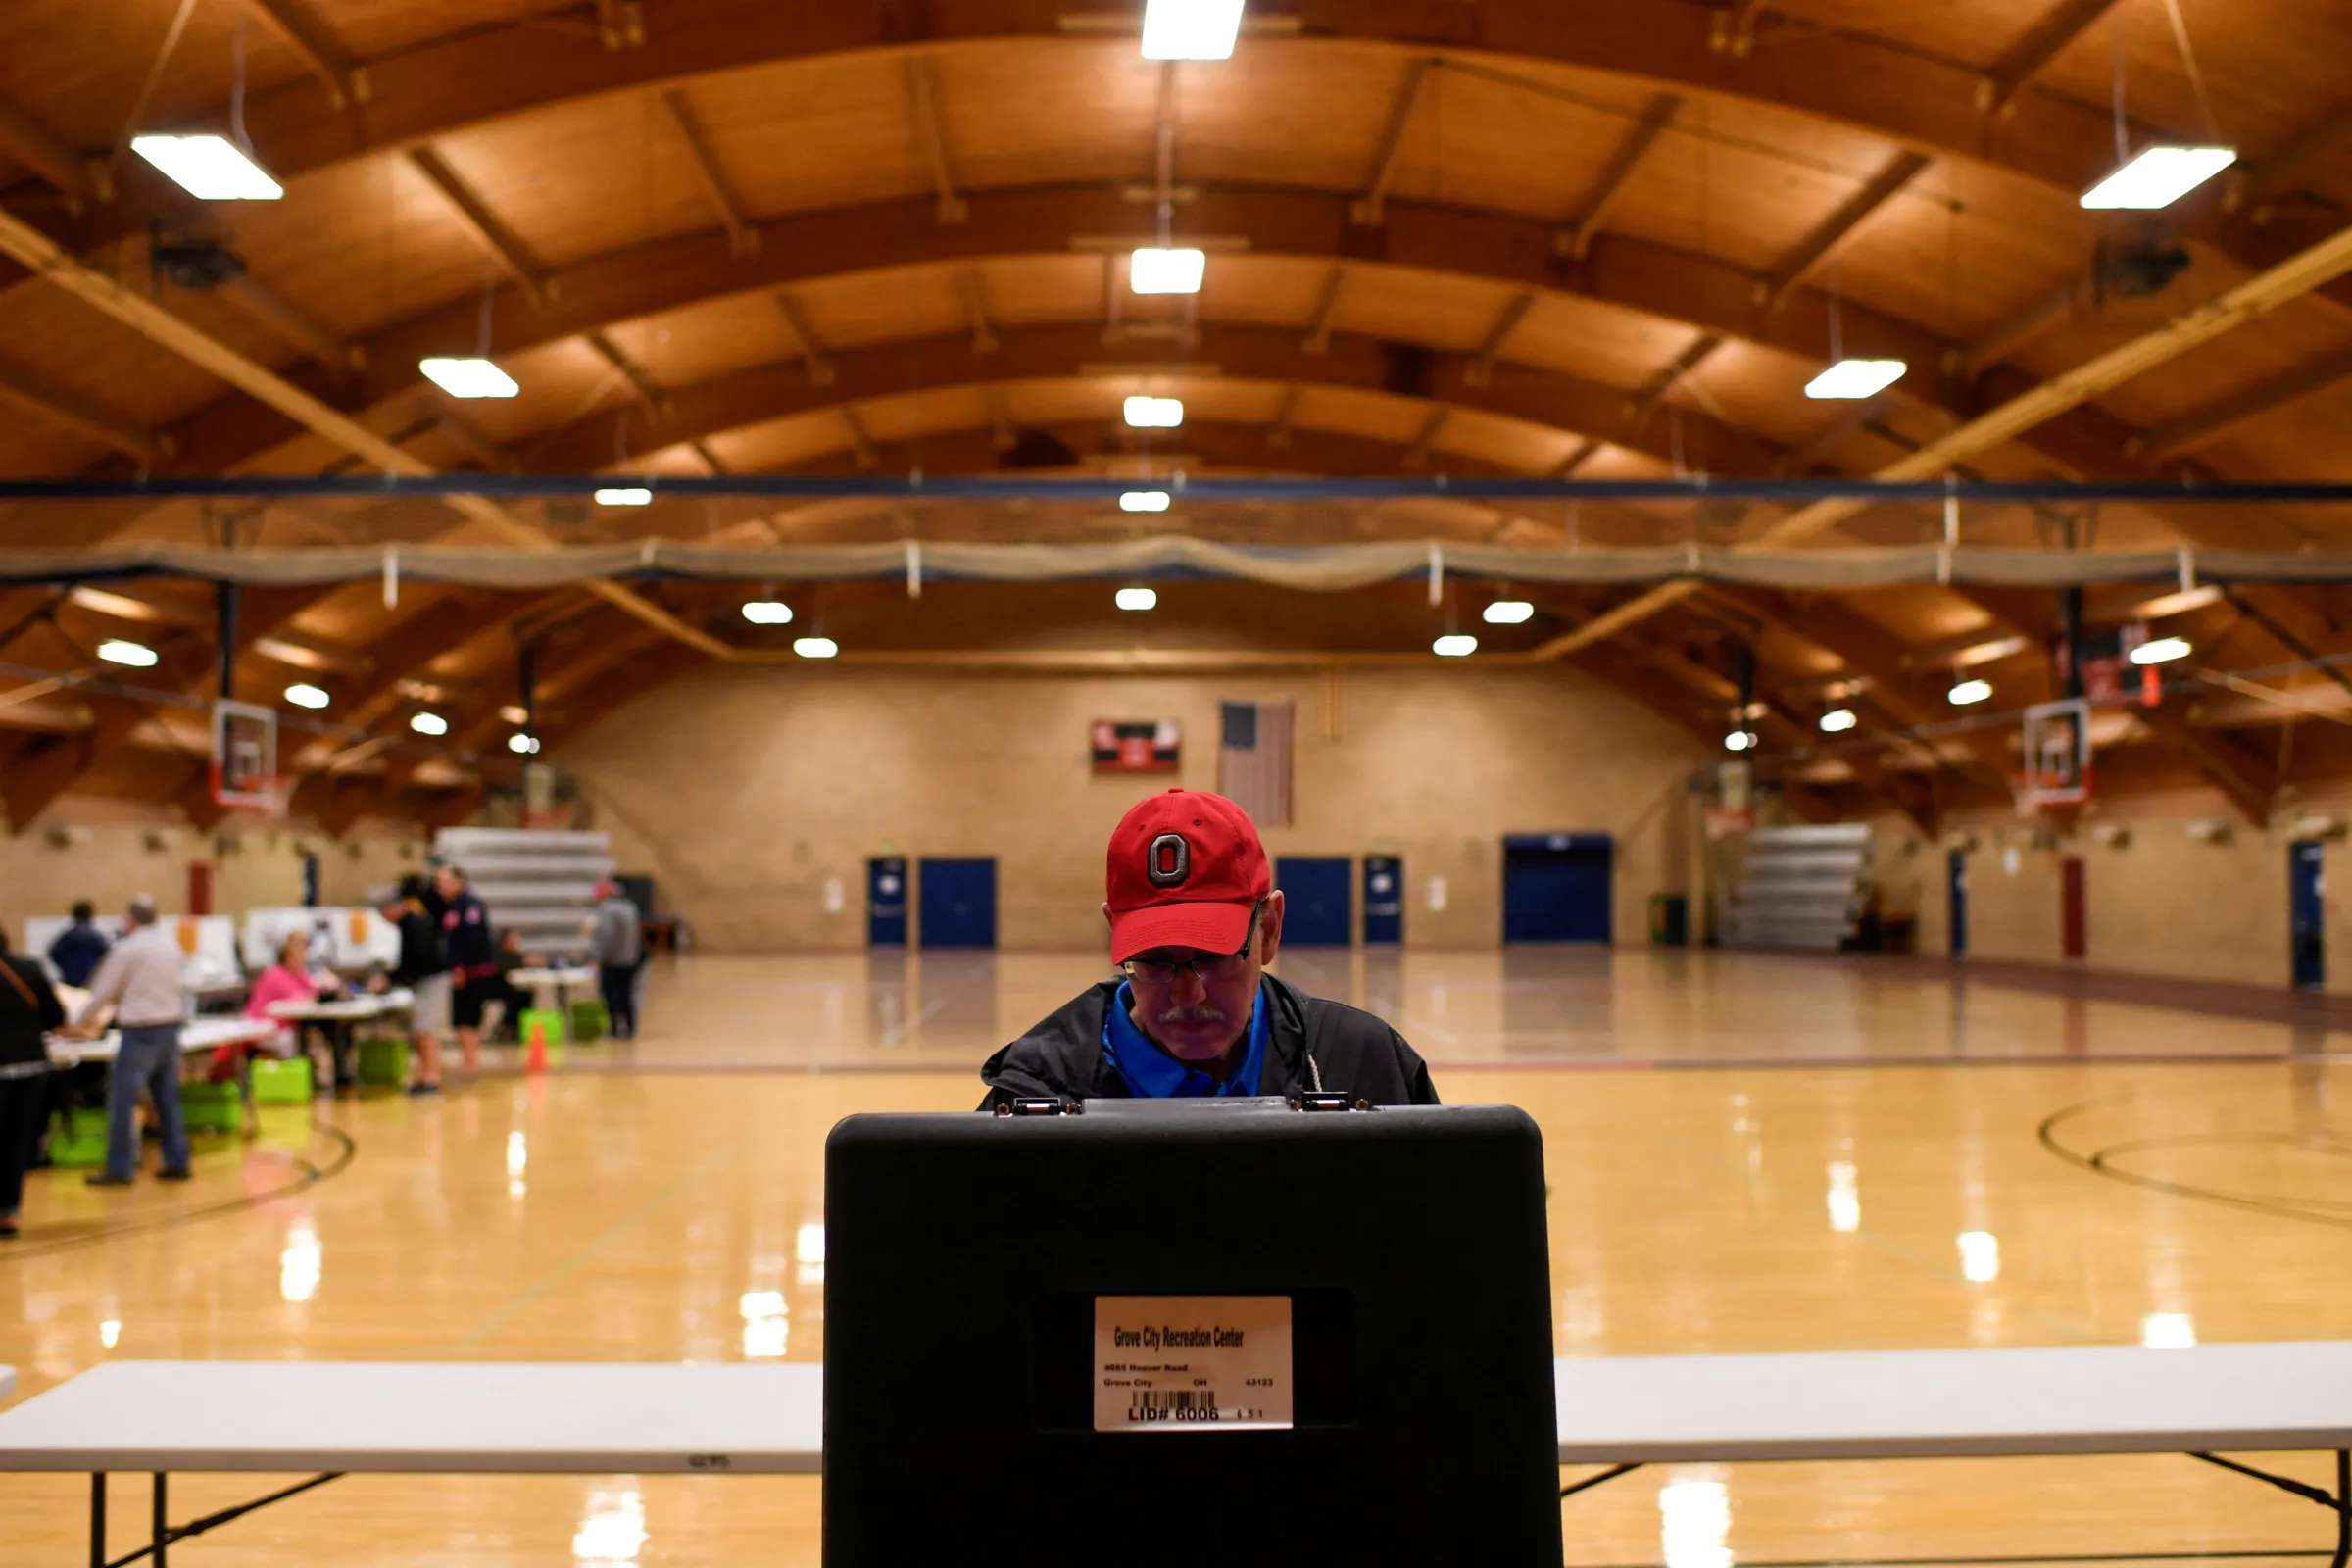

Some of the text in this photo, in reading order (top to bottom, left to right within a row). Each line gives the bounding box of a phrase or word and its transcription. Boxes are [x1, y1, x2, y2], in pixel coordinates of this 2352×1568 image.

[1148, 833, 1190, 887] O
[1114, 1325, 1244, 1351] Grove City Recreation Center
[1164, 1363, 1188, 1372] Road
[1103, 1378, 1273, 1388] Grove City OH 43123
[1128, 1408, 1169, 1421] LID#
[1175, 1407, 1219, 1421] 6006
